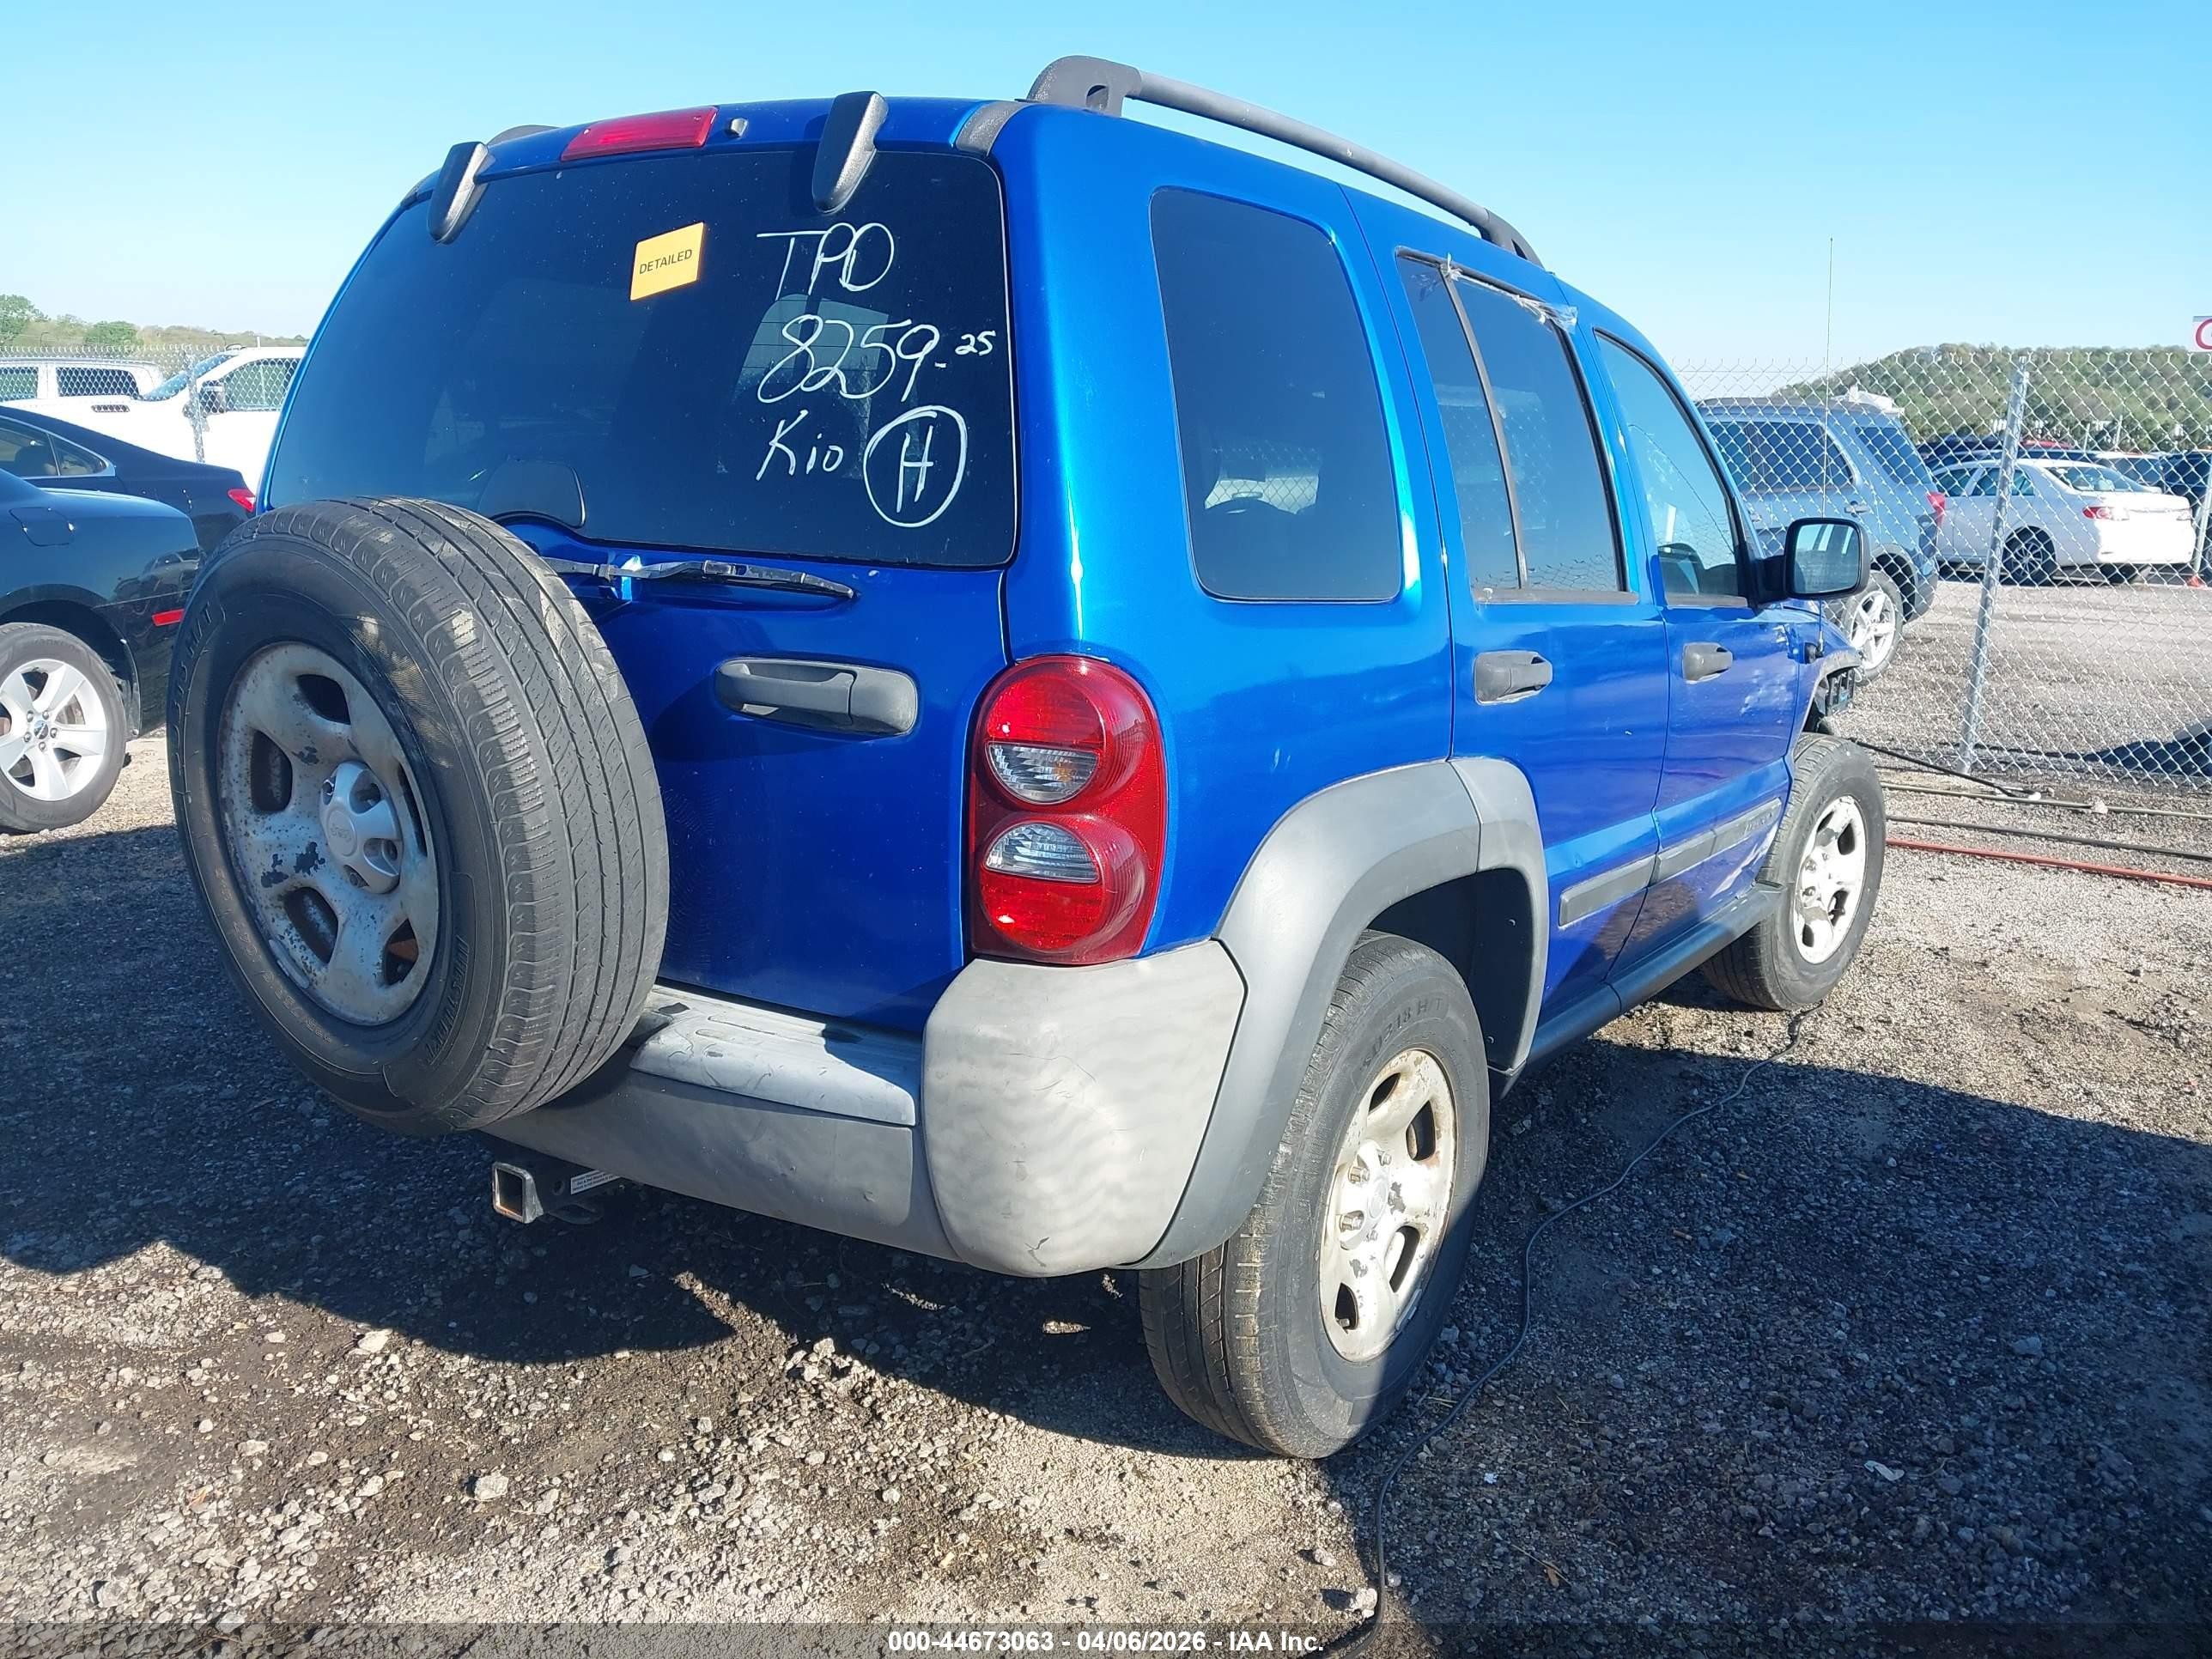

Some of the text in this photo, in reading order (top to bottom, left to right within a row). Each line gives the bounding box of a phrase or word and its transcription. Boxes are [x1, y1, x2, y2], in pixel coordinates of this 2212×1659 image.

[639, 249, 693, 275] DETAILED
[757, 222, 895, 301] TPD
[896, 425, 934, 513] H
